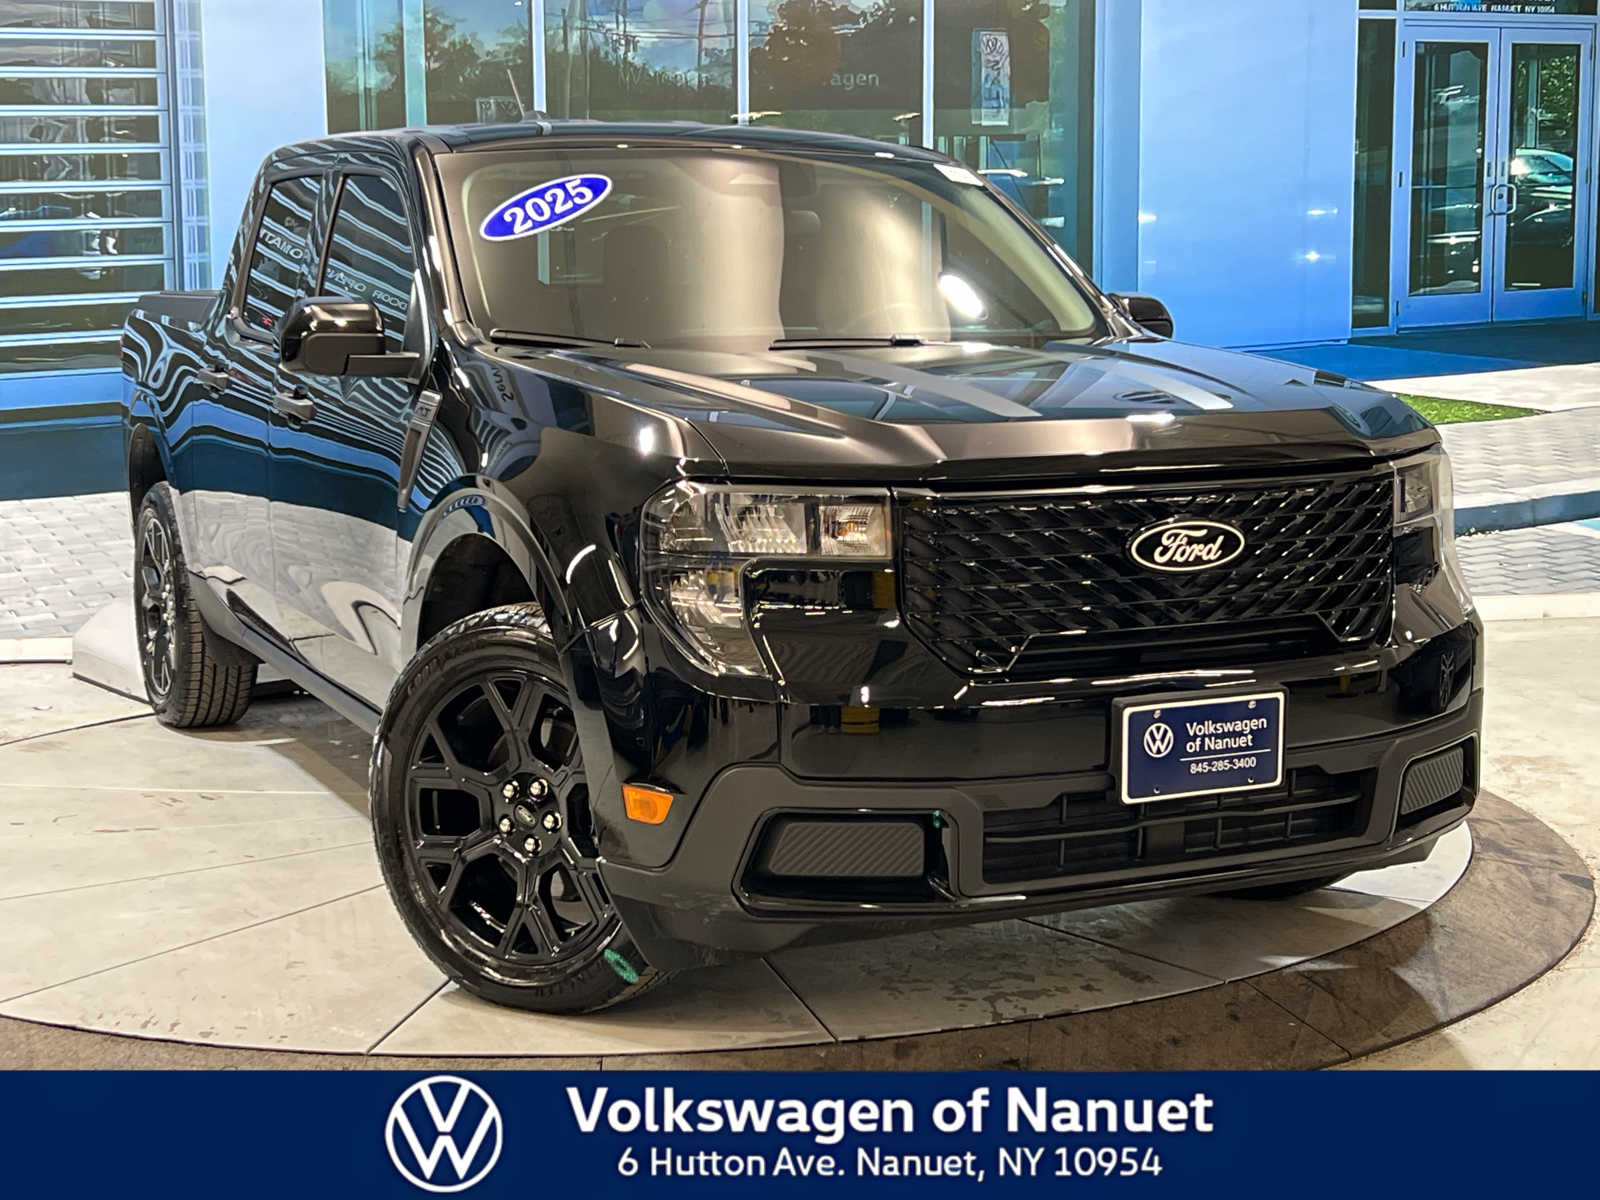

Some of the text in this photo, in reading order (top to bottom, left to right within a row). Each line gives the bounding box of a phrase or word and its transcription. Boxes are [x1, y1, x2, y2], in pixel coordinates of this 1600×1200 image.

[503, 178, 594, 234] 2025
[1153, 529, 1225, 563] Ford
[1186, 717, 1268, 737] Volkswagen
[1186, 734, 1254, 753] of Nanuet
[1190, 756, 1257, 774] 845-285-3400
